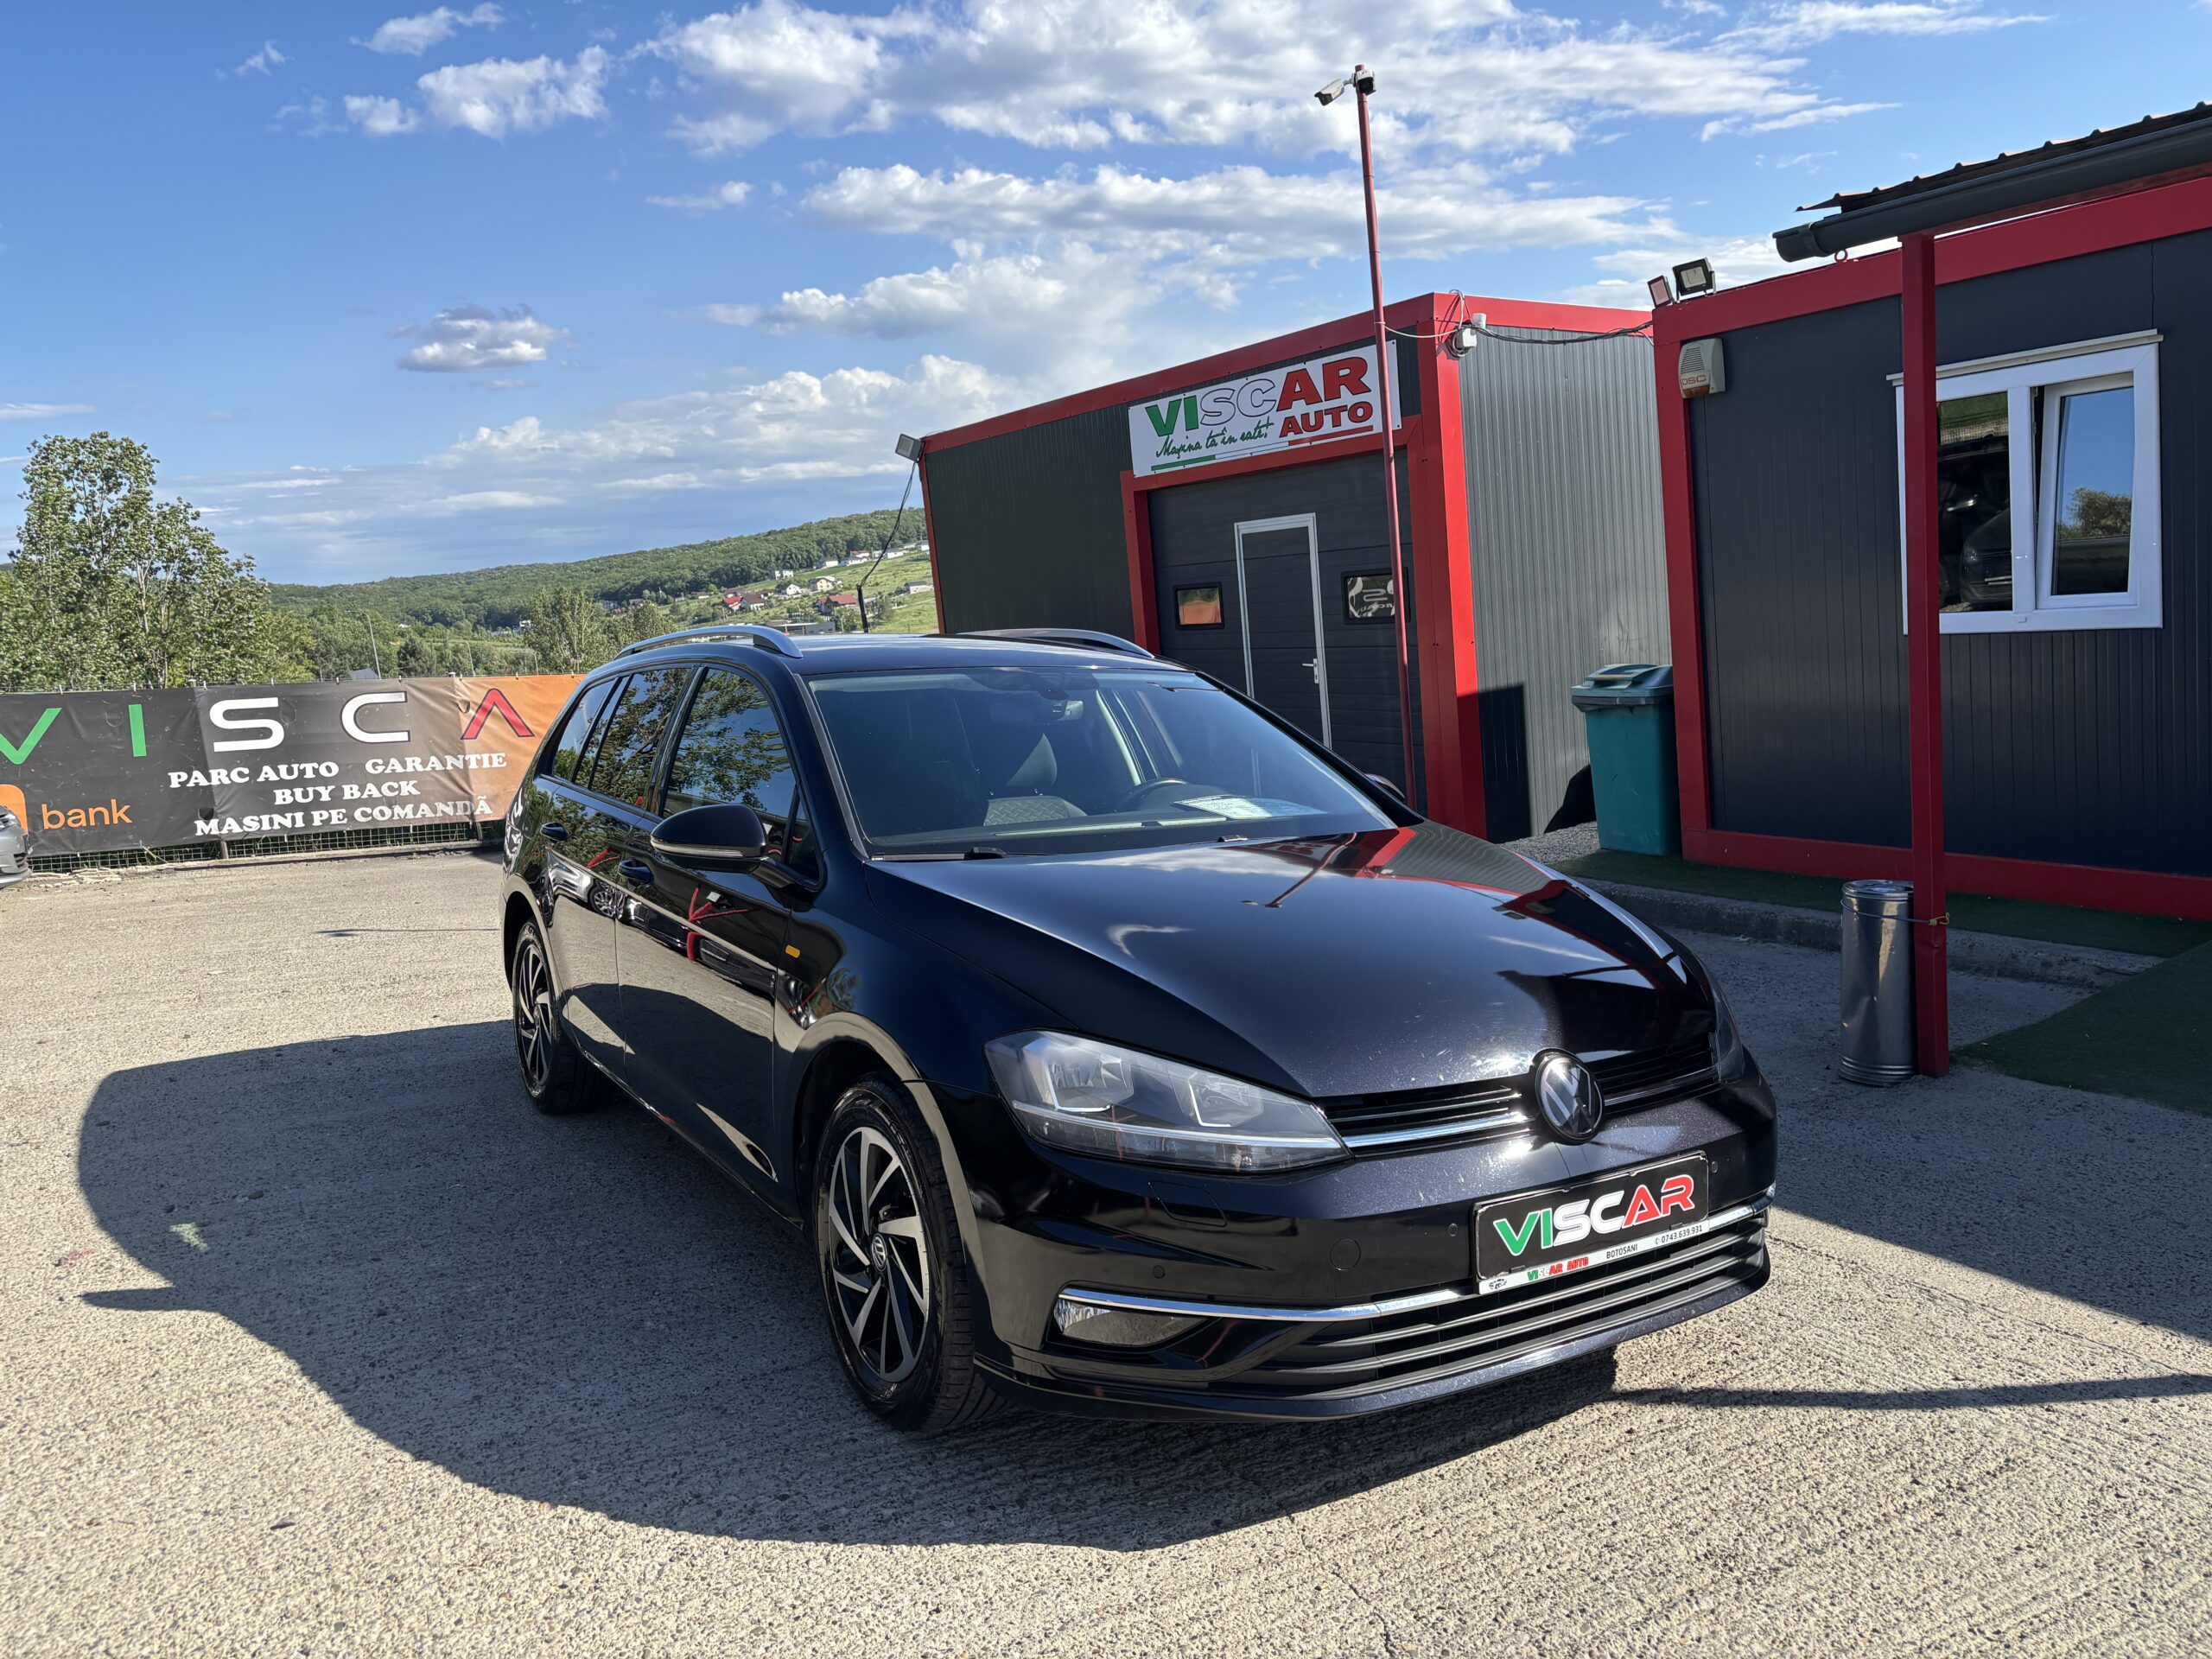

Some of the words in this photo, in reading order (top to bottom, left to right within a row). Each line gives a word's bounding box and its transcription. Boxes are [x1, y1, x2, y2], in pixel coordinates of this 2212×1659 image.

[1145, 356, 1372, 438] VISCAR
[1279, 401, 1374, 438] AUTO
[168, 766, 250, 789] PARC
[257, 761, 340, 783] AUTO
[365, 753, 508, 775] GARANTIE
[273, 785, 336, 805] BUY
[342, 780, 421, 801] BACK
[41, 799, 132, 829] bank
[194, 811, 306, 836] MASINI
[311, 808, 349, 827] PE
[1493, 1174, 1694, 1256] VISCAR
[1606, 1243, 1638, 1259] BOTOSANI
[1661, 1224, 1703, 1243] 0743.639.931
